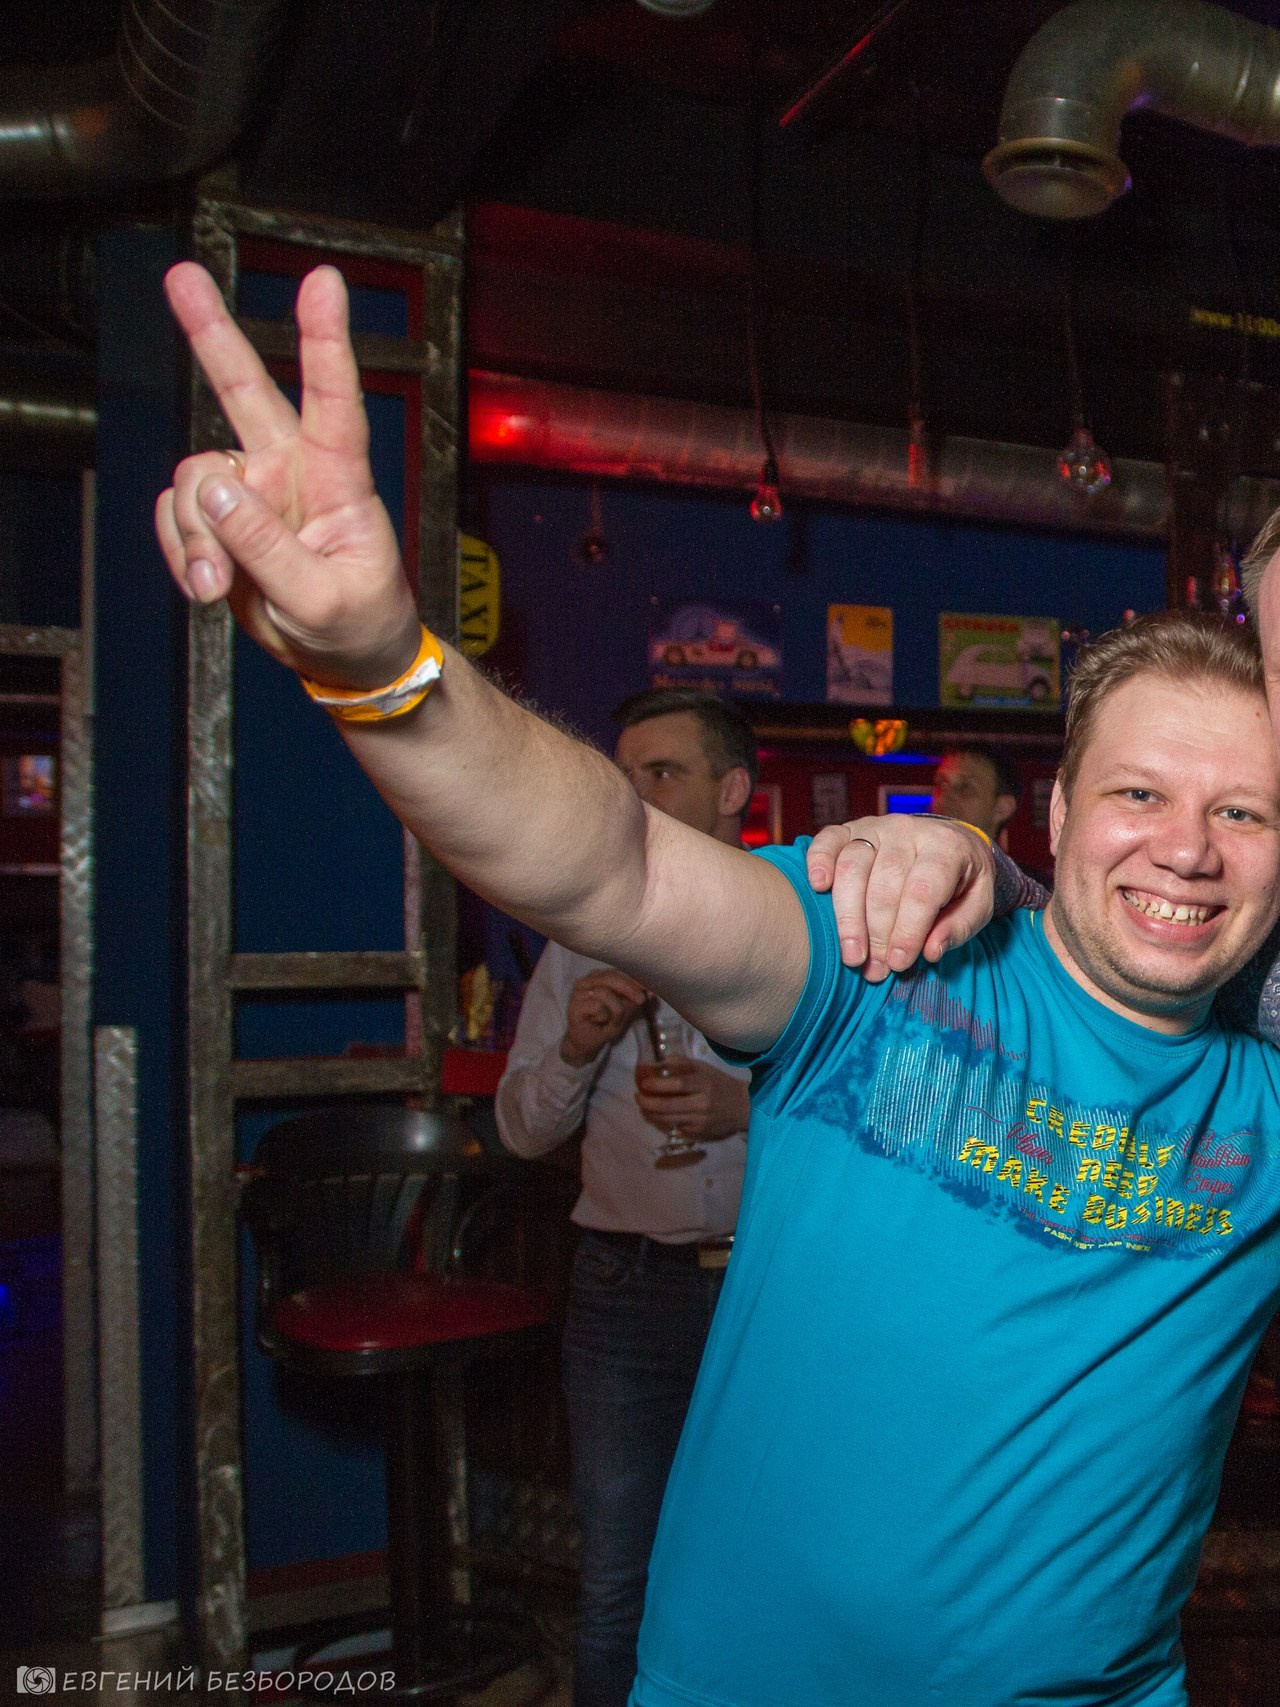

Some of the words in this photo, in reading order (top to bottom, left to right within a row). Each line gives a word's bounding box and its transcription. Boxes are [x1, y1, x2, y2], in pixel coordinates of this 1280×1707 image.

[958, 1135, 1070, 1214] MAKE
[1082, 1193, 1233, 1235] BUSINESS
[1076, 1158, 1158, 1199] NEED
